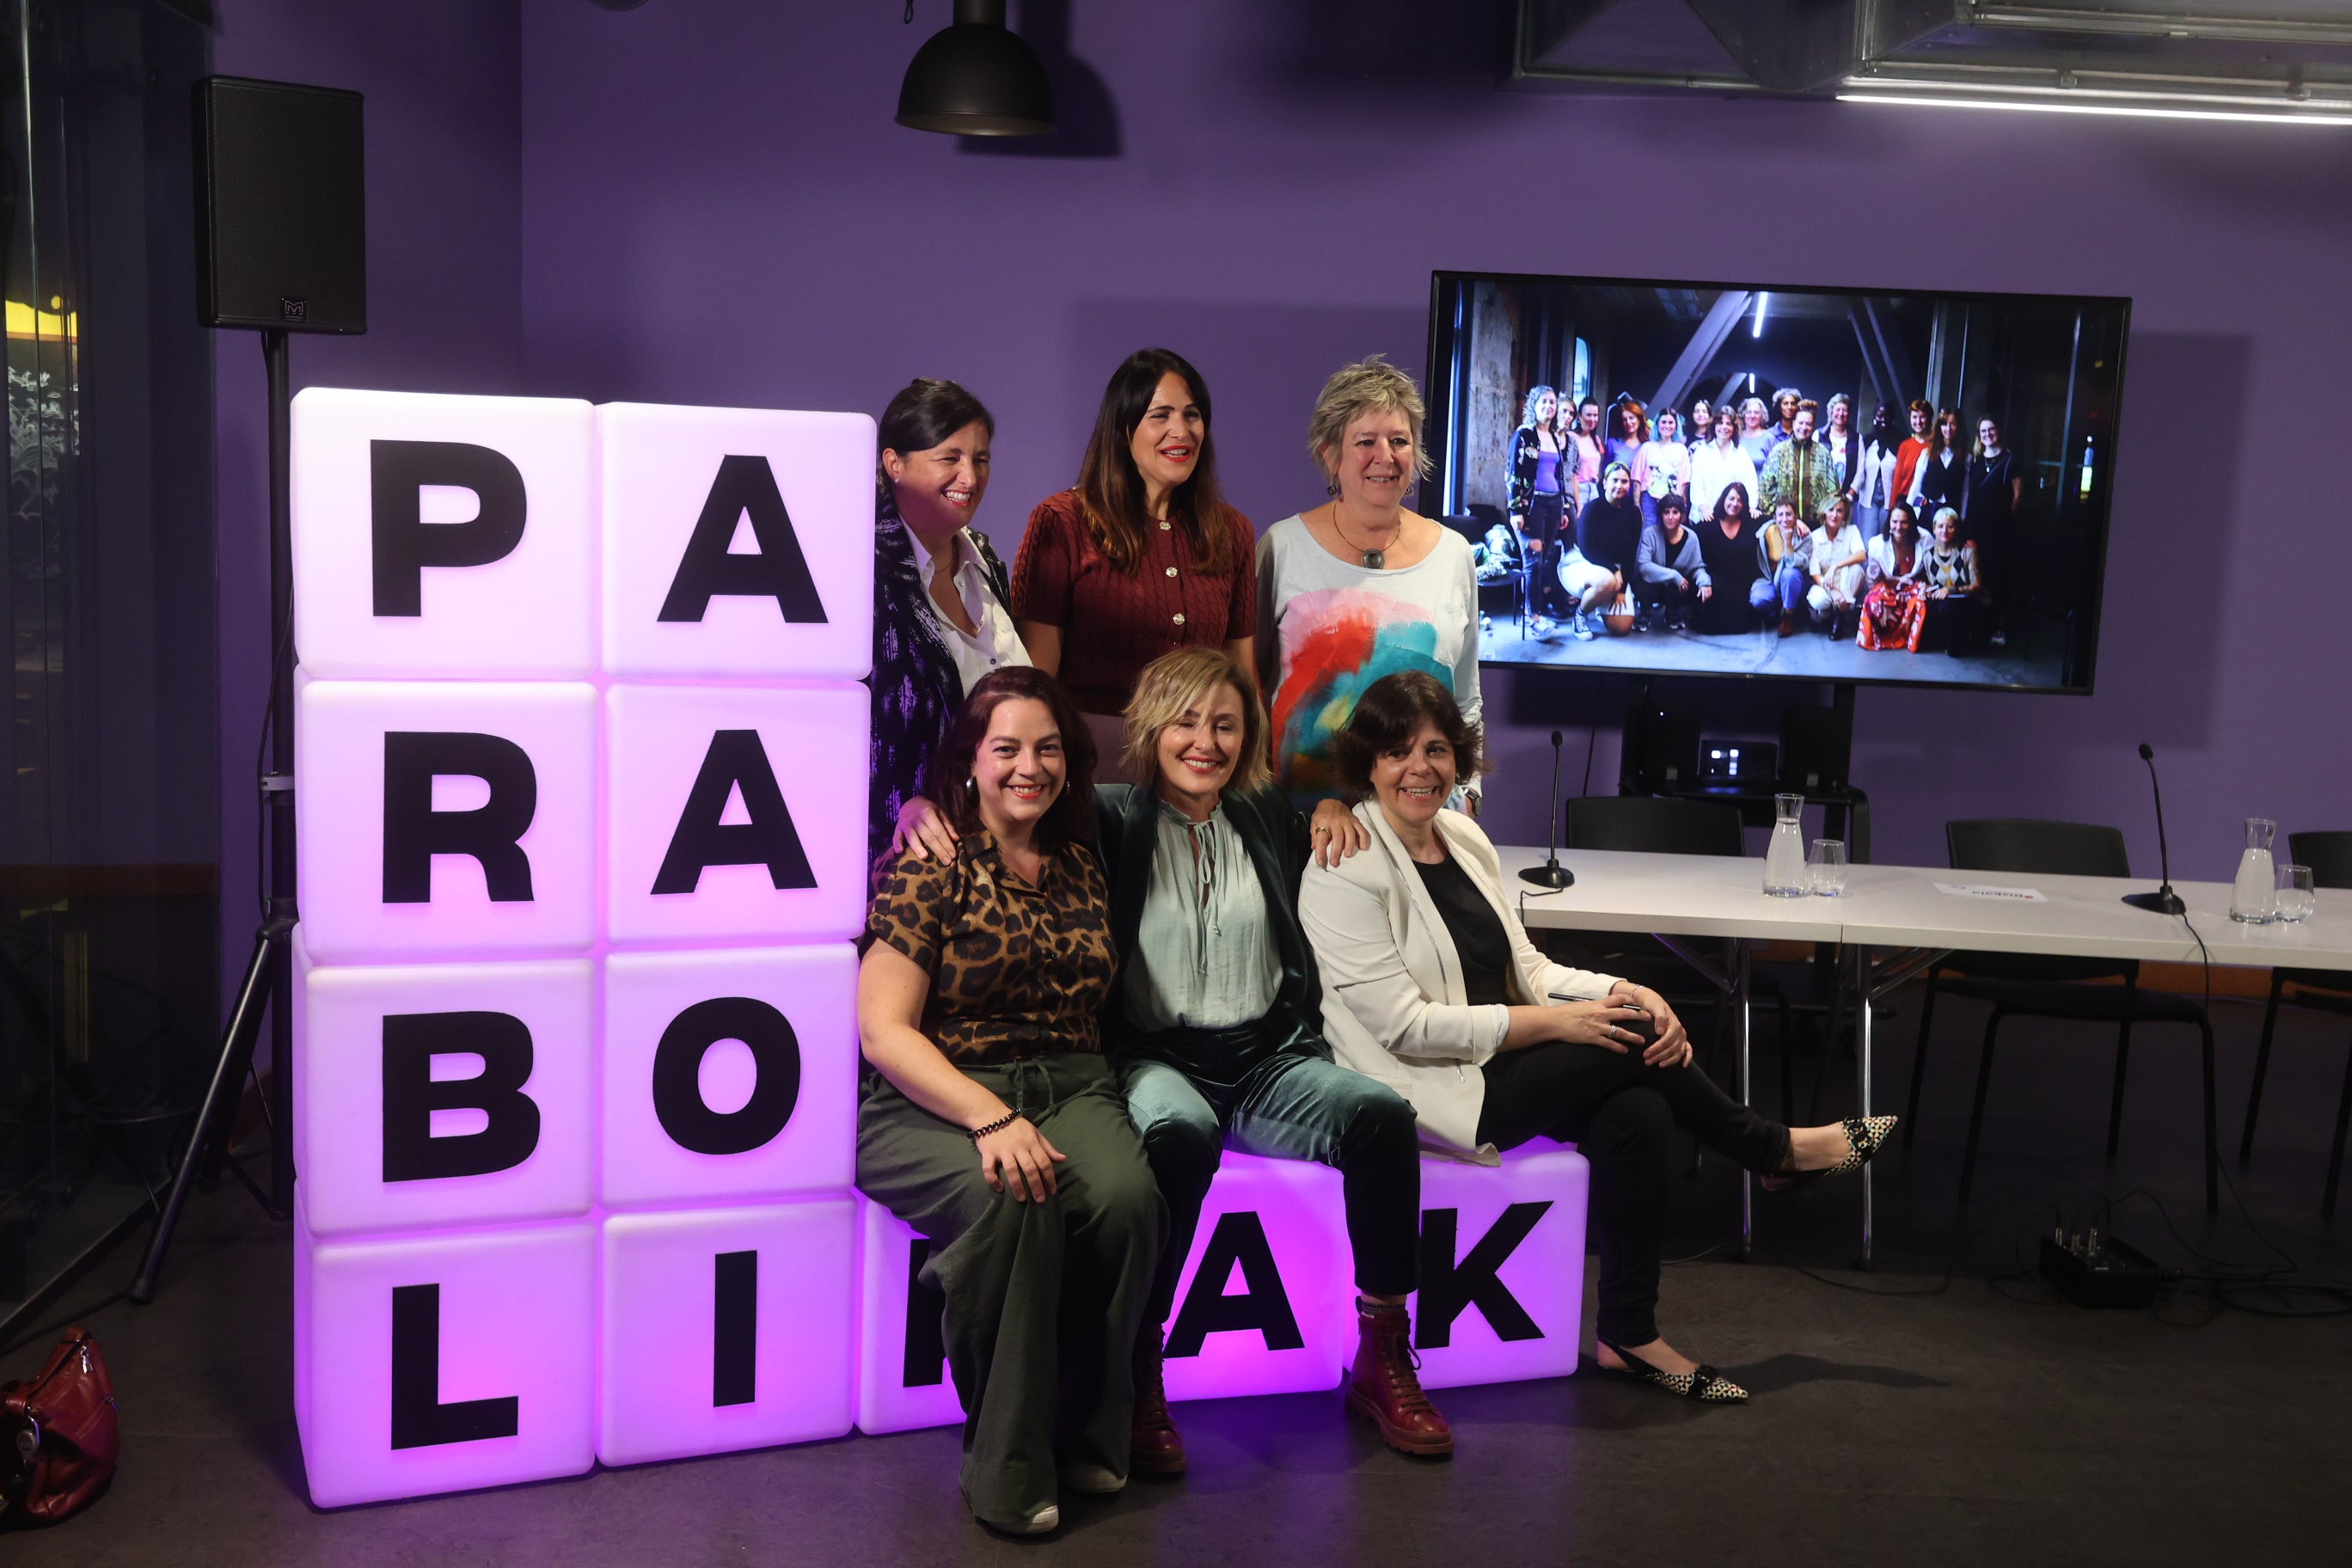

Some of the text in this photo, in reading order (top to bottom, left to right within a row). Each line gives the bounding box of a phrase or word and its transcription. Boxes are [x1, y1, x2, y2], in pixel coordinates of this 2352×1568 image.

[370, 439, 829, 623] PA
[383, 729, 818, 903] RA
[383, 996, 800, 1183] BO
